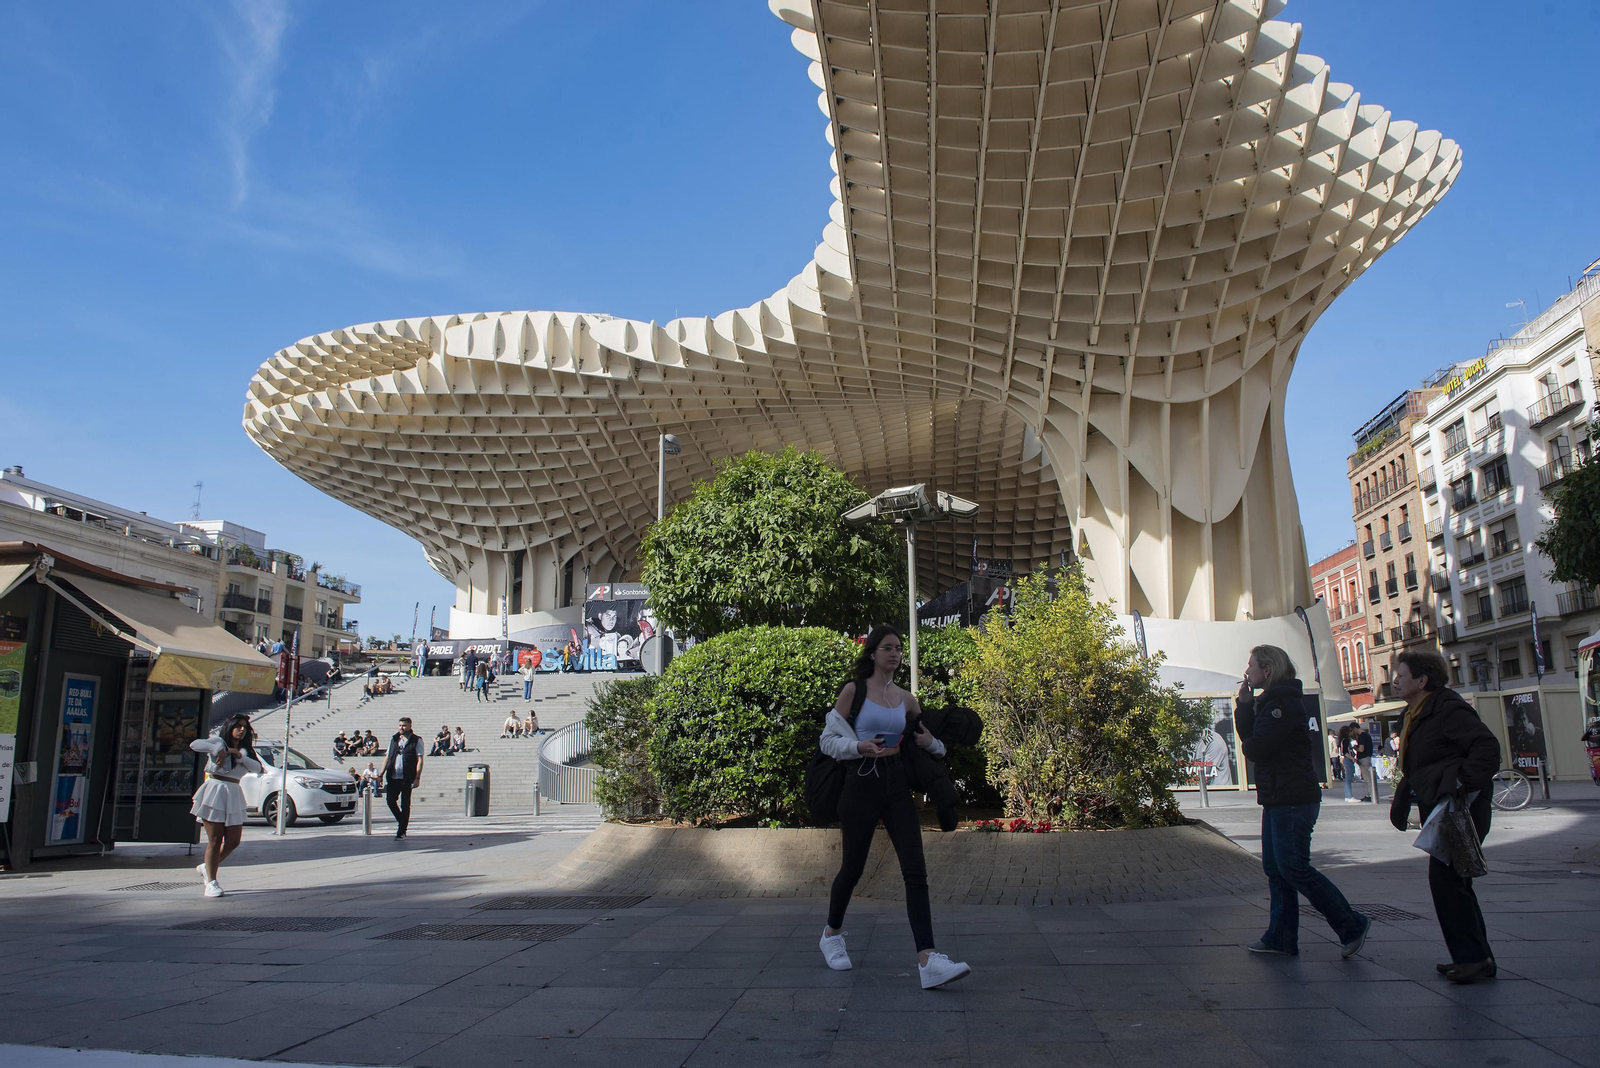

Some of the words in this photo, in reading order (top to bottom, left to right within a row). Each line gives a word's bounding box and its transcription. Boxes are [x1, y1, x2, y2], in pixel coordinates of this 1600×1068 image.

[1443, 376, 1463, 396] HOTEL
[1464, 358, 1486, 380] DUCAL
[921, 617, 937, 628] WE
[937, 614, 961, 628] LIVE
[428, 645, 454, 655] PADEL
[476, 644, 502, 654] PADEL
[541, 638, 618, 671] Sevilla
[69, 688, 79, 697] RED
[80, 689, 92, 698] BULL
[1518, 693, 1534, 703] PADEL
[68, 698, 74, 706] TE
[75, 698, 82, 707] DA
